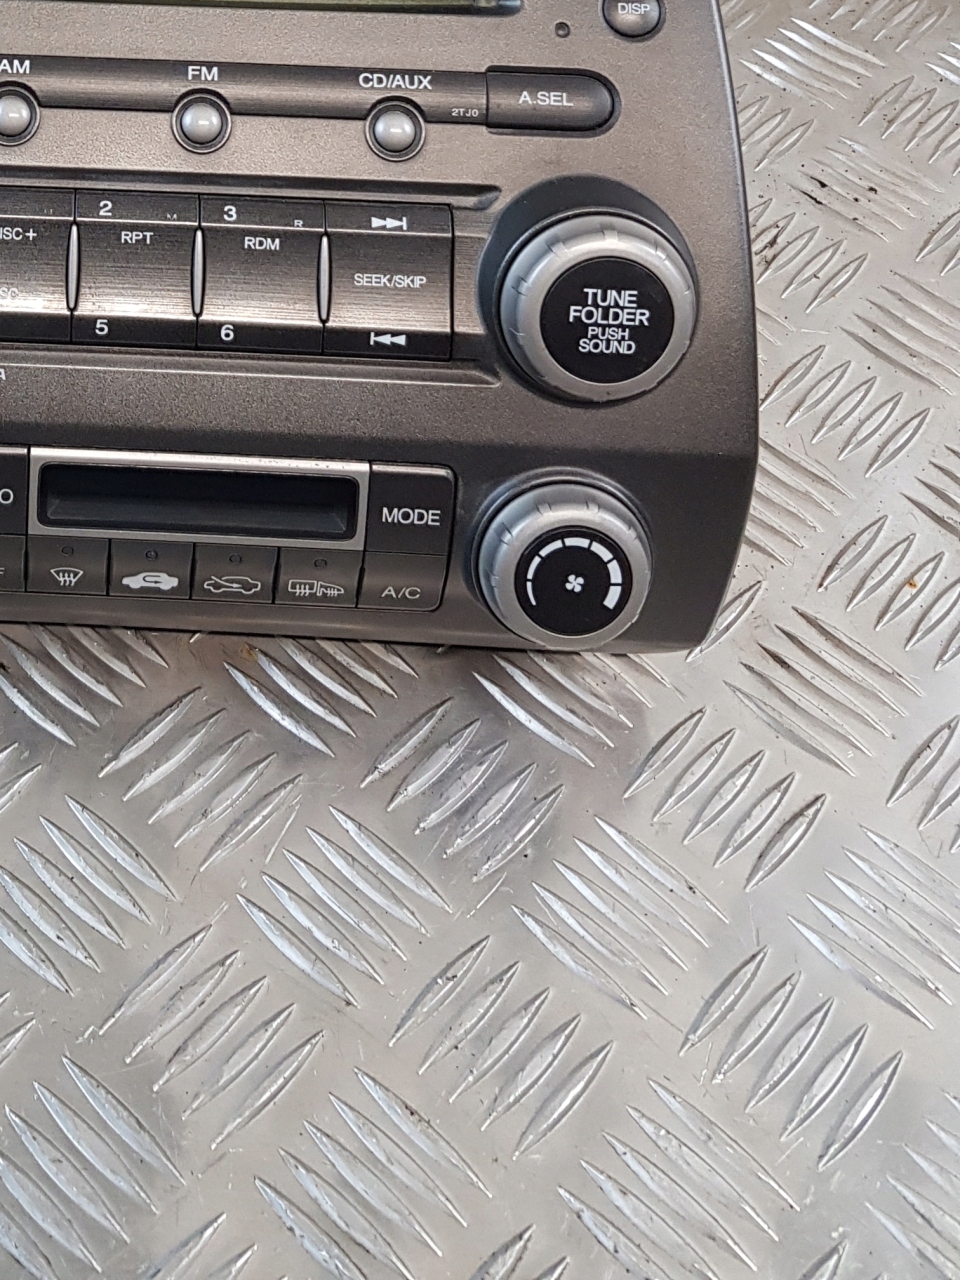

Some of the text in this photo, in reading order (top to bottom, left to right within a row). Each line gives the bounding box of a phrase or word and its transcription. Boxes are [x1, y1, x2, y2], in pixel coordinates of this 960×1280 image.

[617, 2, 650, 15] DISP
[187, 66, 218, 81] FM
[358, 72, 432, 90] CD/AUX
[518, 91, 574, 107] A.SEL
[99, 200, 113, 216] 2
[223, 205, 237, 221] 3
[120, 231, 153, 245] RPT
[244, 236, 280, 251] RDM
[354, 273, 427, 288] SEEK/SKIP
[583, 288, 638, 307] TUNE
[569, 306, 650, 326] FOLDER
[95, 319, 109, 335] 5
[220, 324, 235, 341] 6
[588, 326, 629, 340] PUSH
[578, 338, 636, 354] SOUND
[381, 506, 441, 526] MODE
[380, 584, 420, 600] A/C
